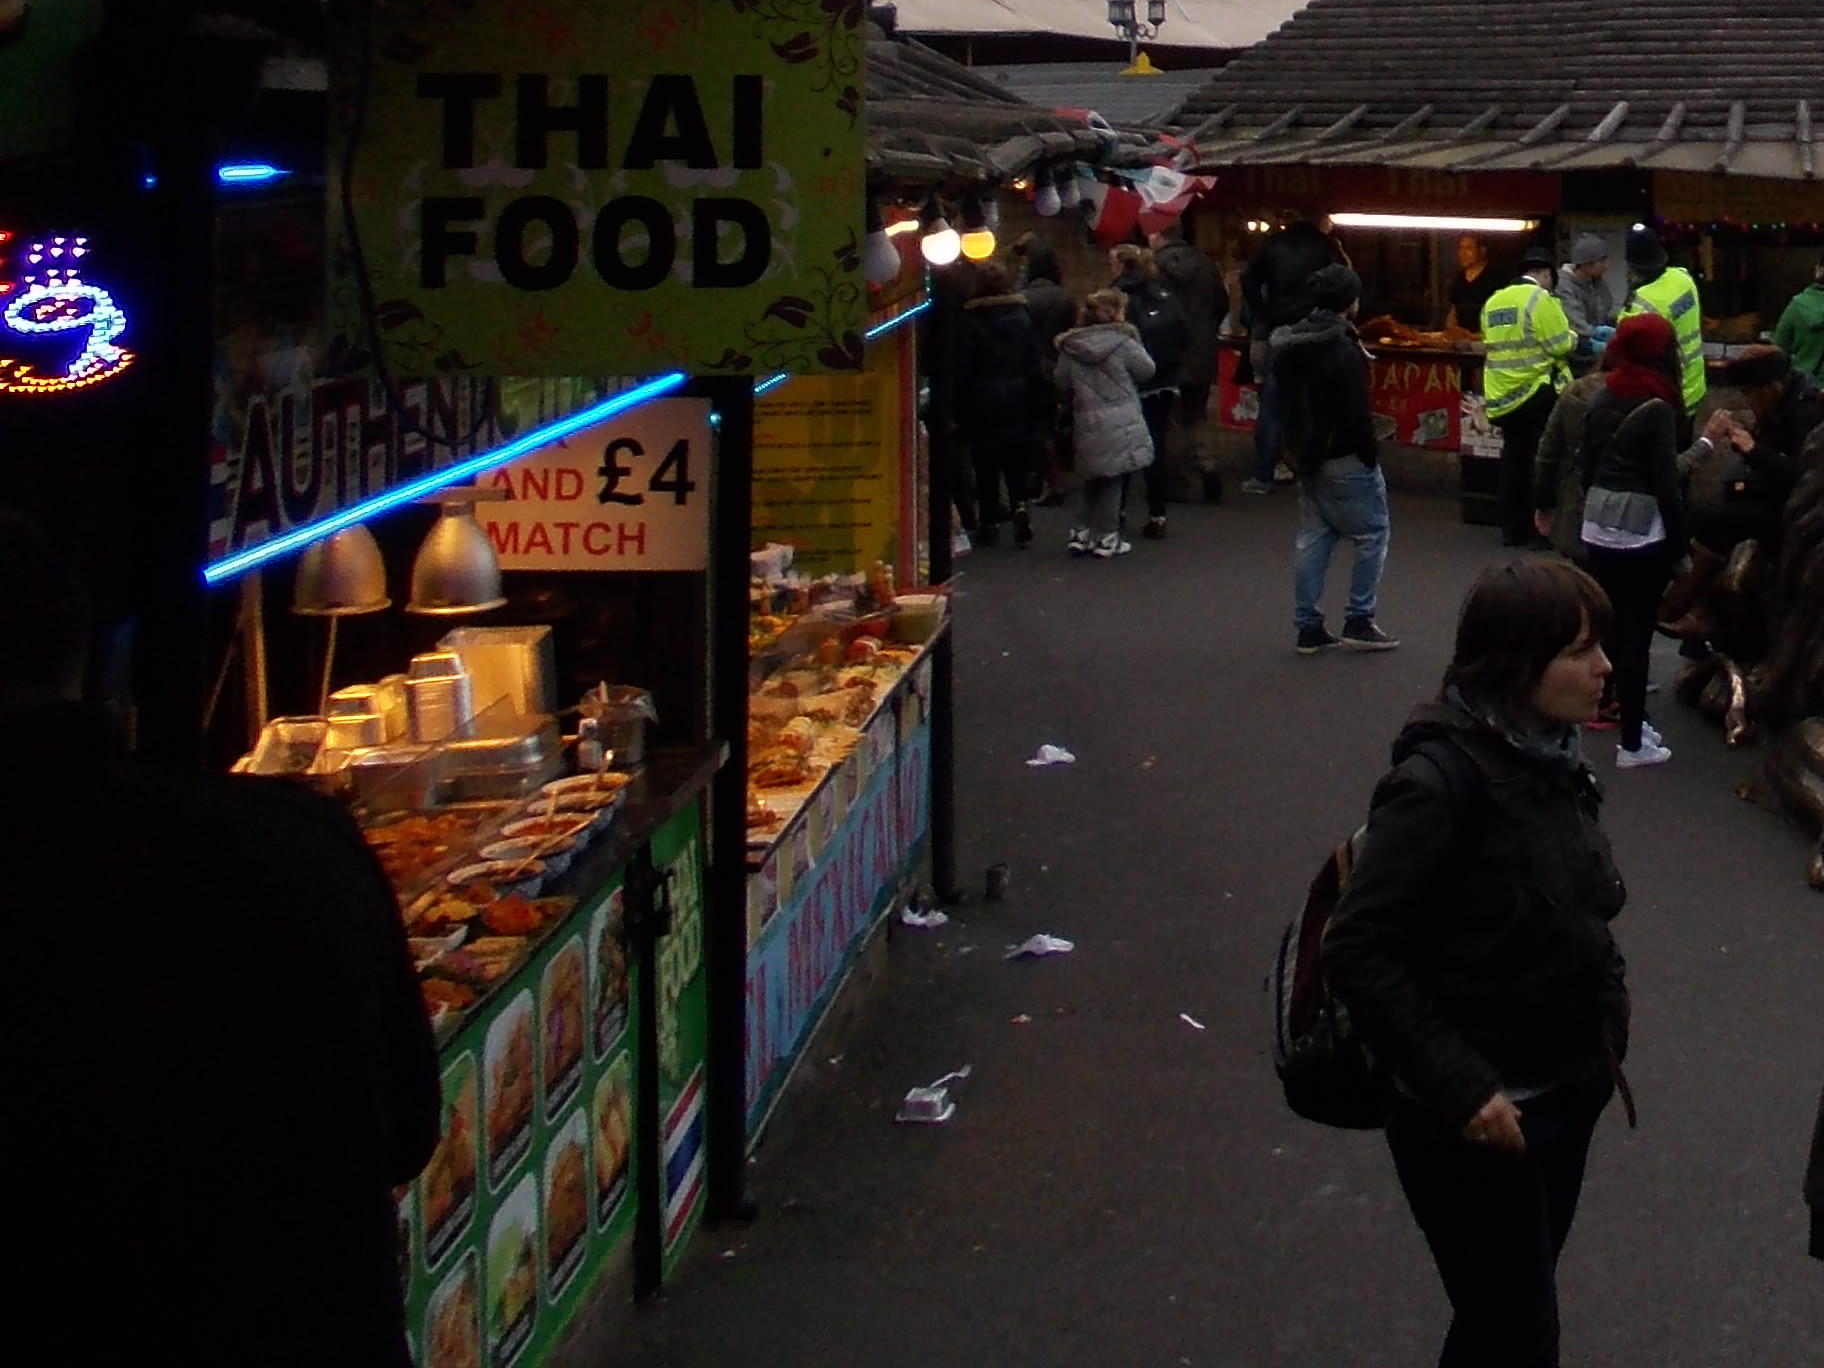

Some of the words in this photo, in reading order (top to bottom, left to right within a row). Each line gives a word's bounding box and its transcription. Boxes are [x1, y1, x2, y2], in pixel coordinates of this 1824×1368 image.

[417, 73, 763, 169] THAI
[420, 195, 771, 291] FOOD
[491, 468, 584, 501] AND
[597, 438, 696, 506] £4
[487, 521, 646, 556] MATCH
